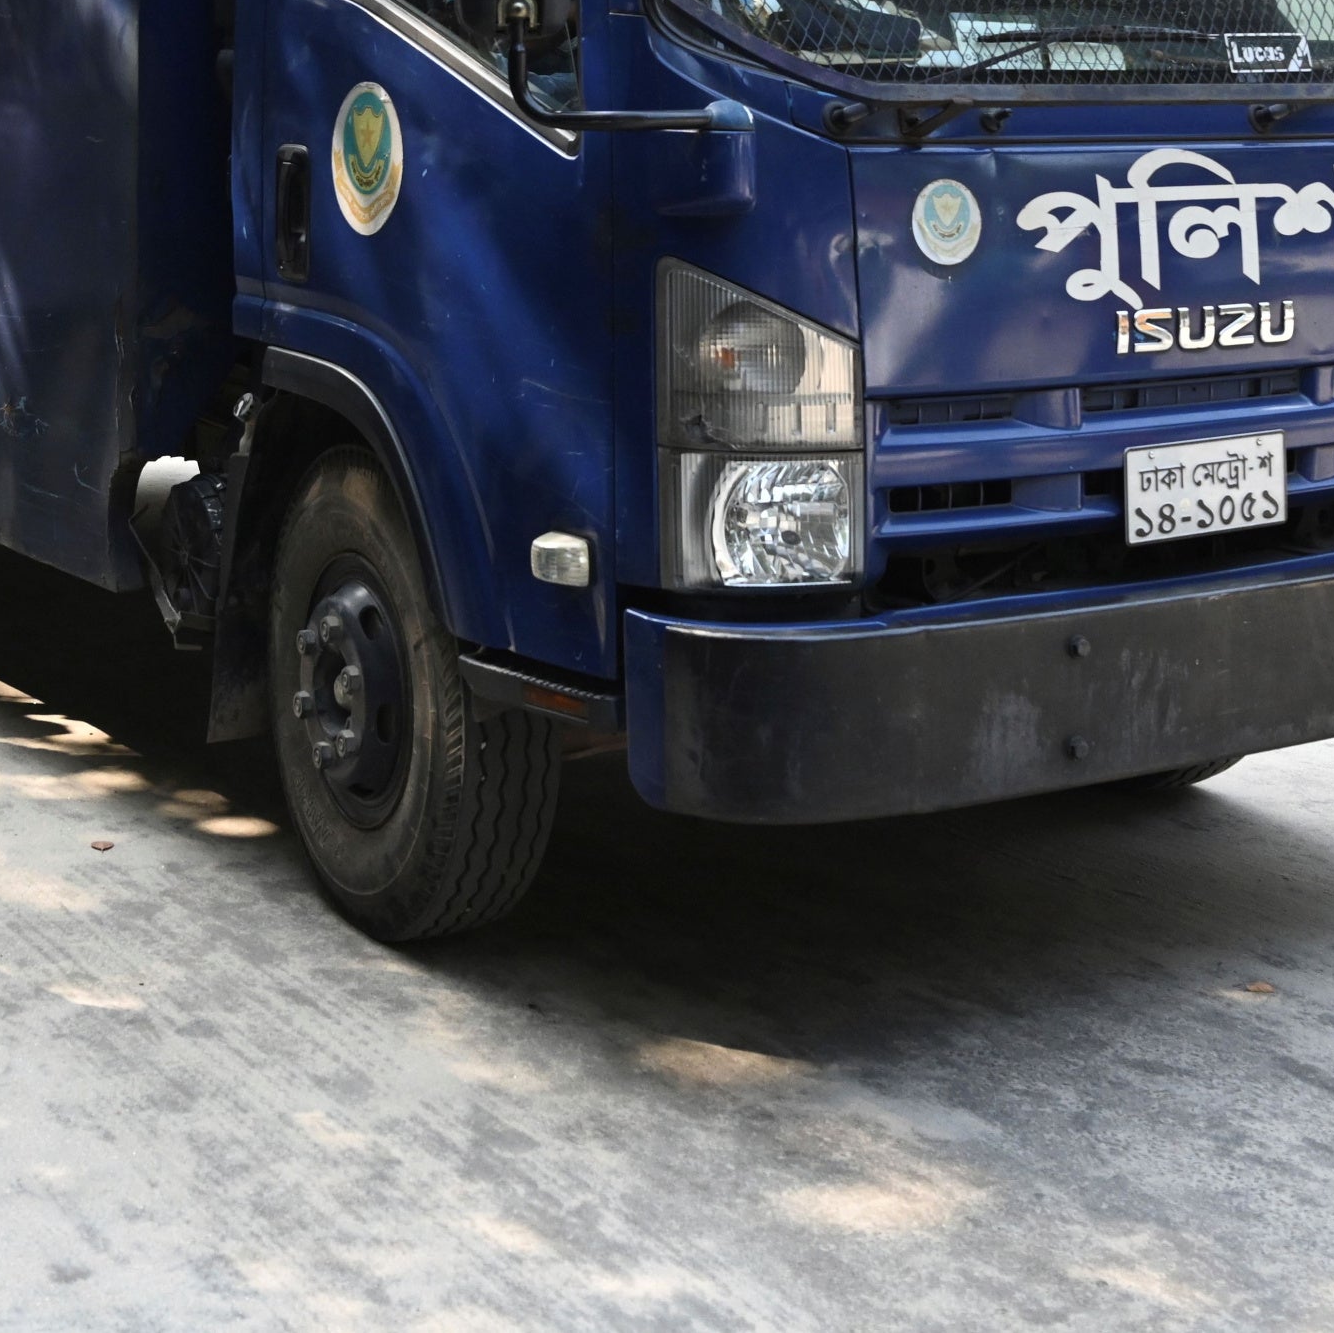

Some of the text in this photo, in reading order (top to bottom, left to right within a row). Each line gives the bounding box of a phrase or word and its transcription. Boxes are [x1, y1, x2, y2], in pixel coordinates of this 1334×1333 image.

[1230, 41, 1285, 64] Lucas
[1116, 300, 1294, 354] ISUZU
[1139, 463, 1185, 492] ঢাকা
[1135, 490, 1279, 537] ১৪-১০৫১
